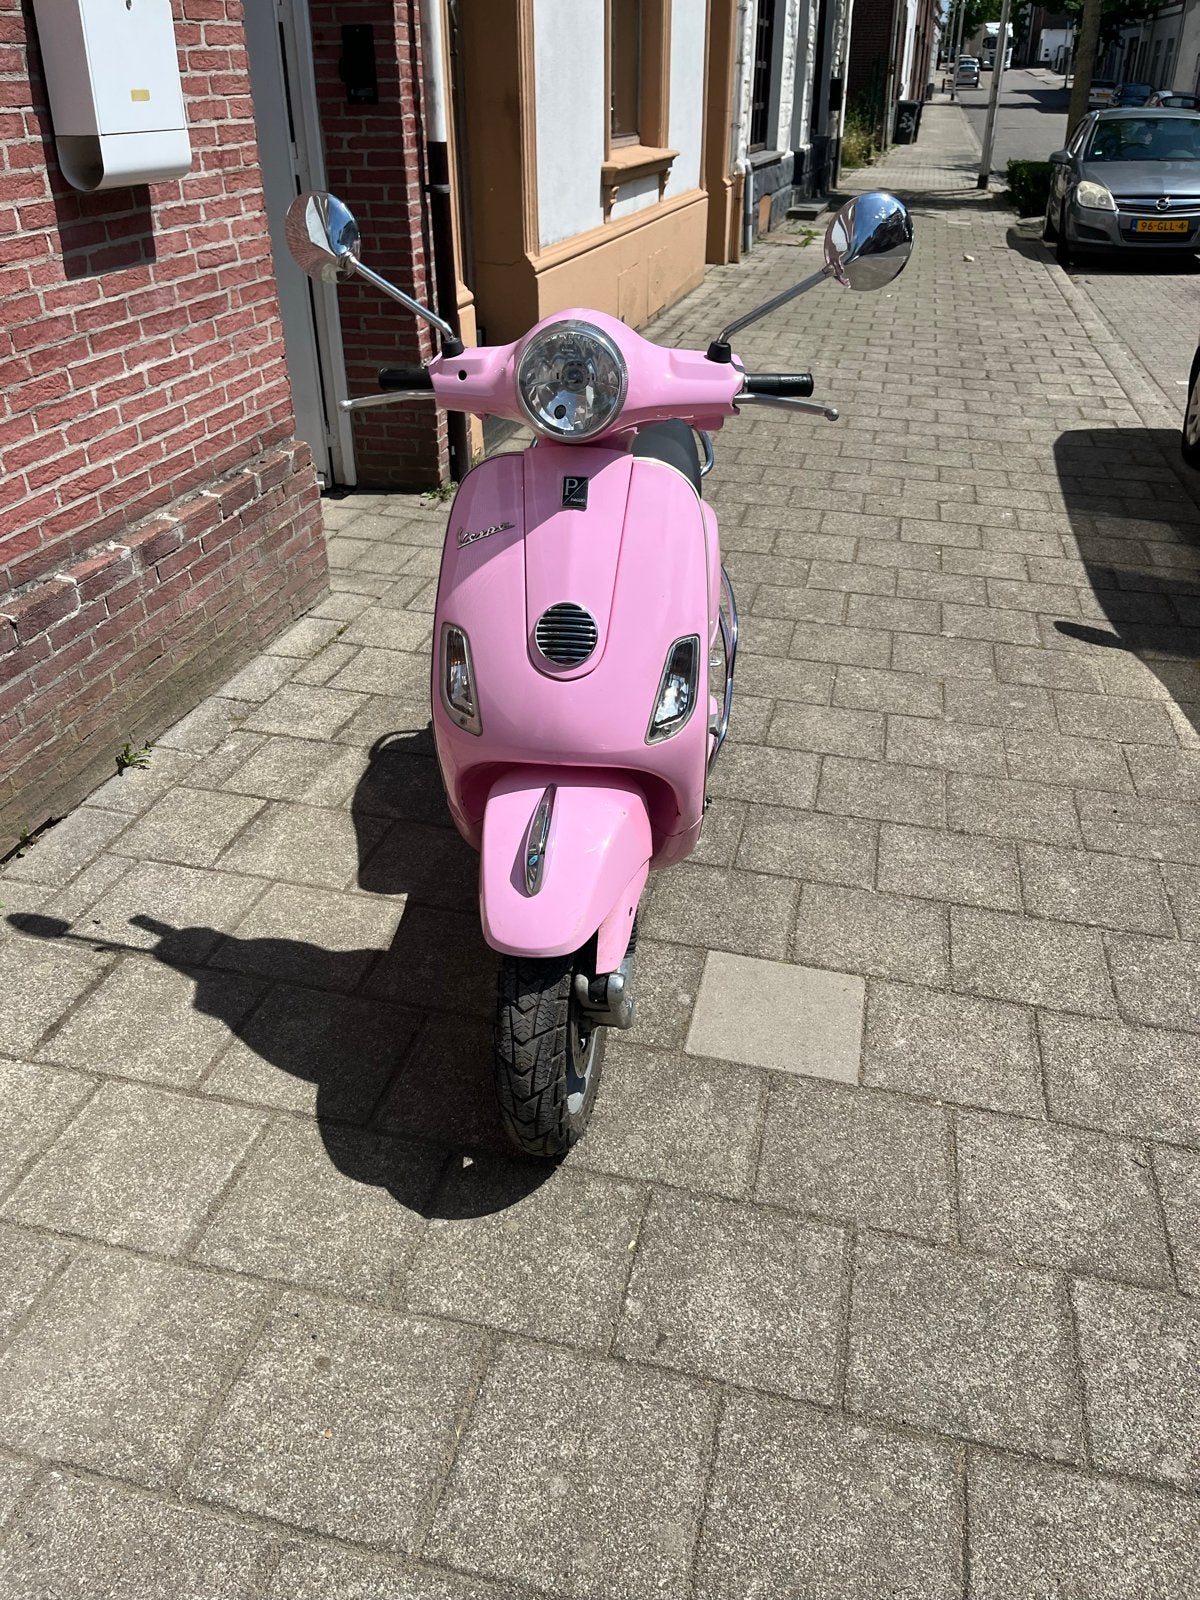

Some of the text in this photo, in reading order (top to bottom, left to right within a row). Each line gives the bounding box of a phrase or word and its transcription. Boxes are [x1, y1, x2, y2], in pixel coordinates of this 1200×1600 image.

[1140, 221, 1186, 231] 96-GLL-4
[564, 478, 579, 496] P
[457, 521, 515, 550] Vespa
